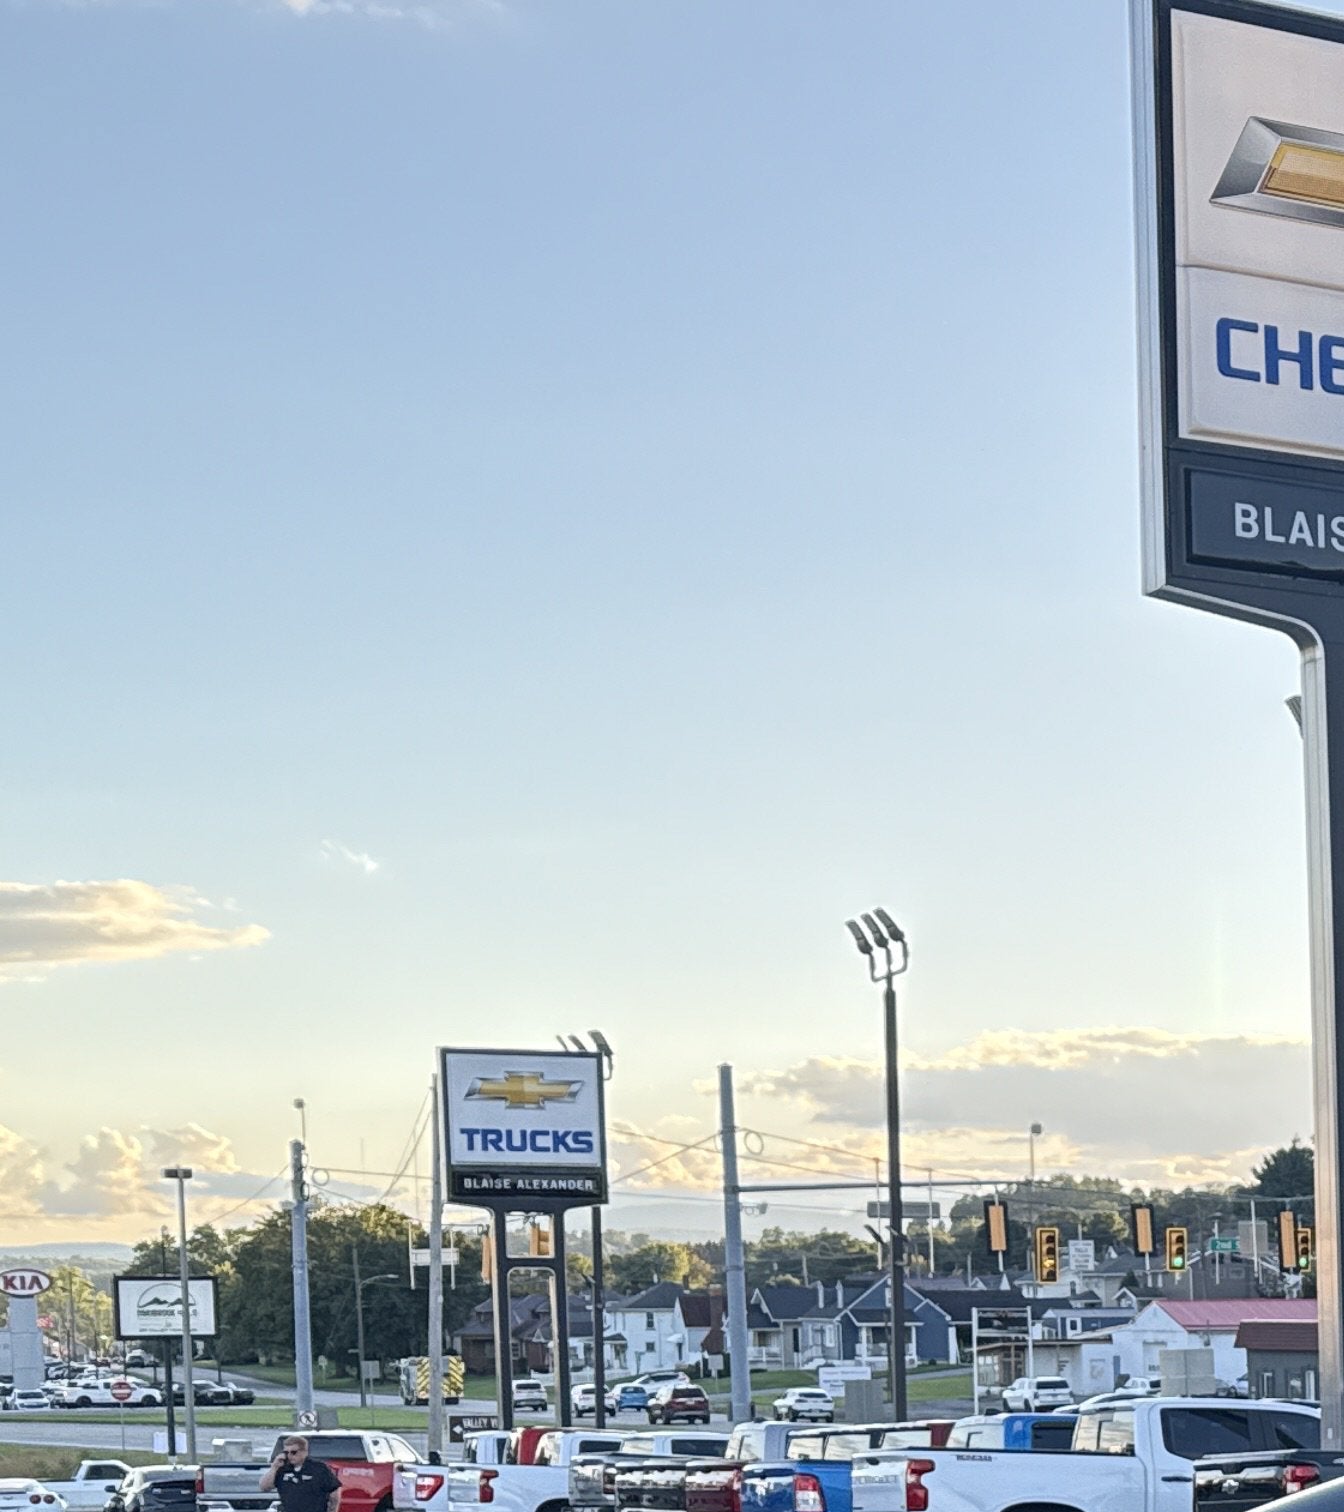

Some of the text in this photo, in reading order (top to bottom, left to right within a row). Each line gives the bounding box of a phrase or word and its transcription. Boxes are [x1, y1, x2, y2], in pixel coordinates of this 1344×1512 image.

[459, 1128, 594, 1153] TRUCKS
[463, 1177, 593, 1191] BLAISE ALEXANDER
[1215, 1240, 1232, 1249] 2nd
[2, 1275, 43, 1290] KIA
